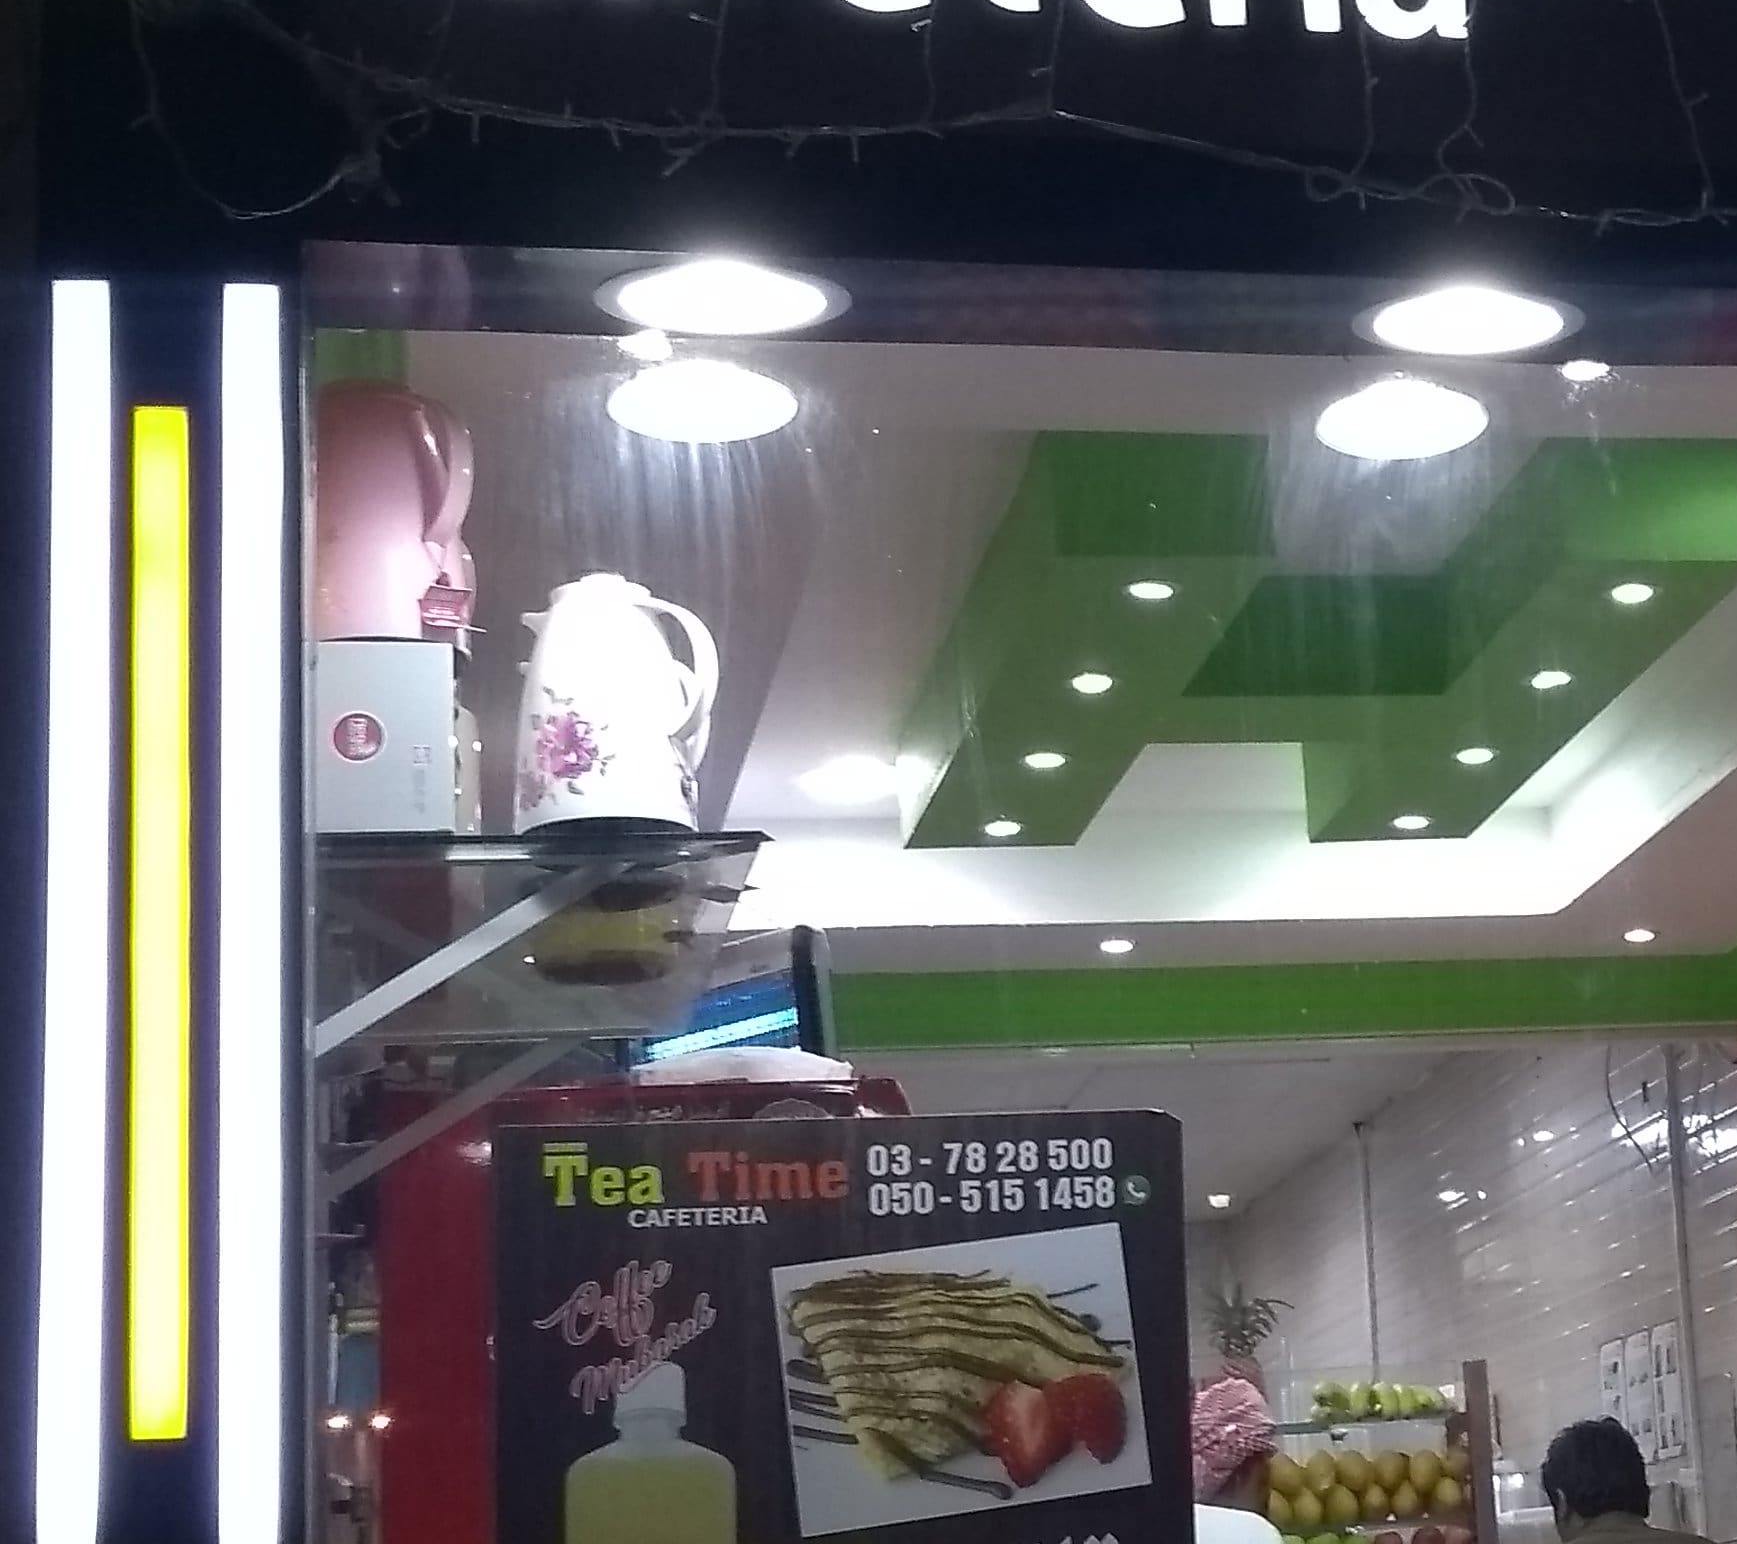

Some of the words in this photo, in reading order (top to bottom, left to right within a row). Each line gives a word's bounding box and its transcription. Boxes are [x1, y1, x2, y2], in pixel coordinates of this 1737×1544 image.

[543, 1142, 666, 1207] Tea
[687, 1150, 850, 1202] Time
[866, 1143, 913, 1177] 03
[943, 1141, 987, 1174] 78
[996, 1140, 1040, 1173] 28
[1047, 1137, 1114, 1171] 500
[867, 1181, 936, 1217] 050
[959, 1178, 1025, 1213] 515
[1034, 1175, 1116, 1210] 1458
[627, 1206, 769, 1229] CAFETERIA
